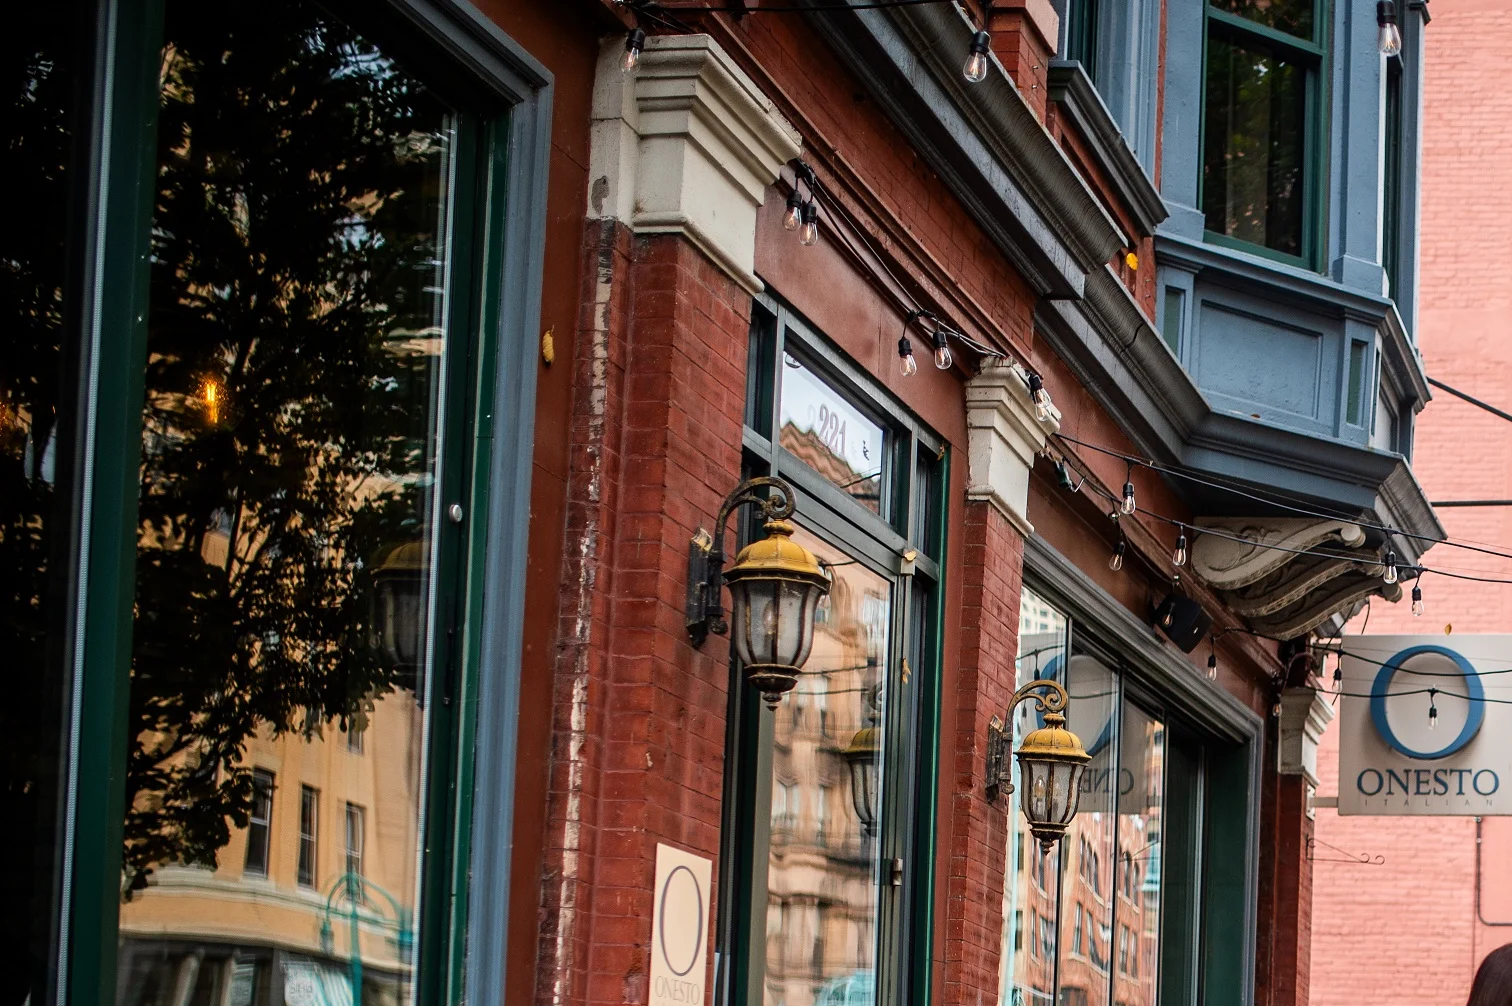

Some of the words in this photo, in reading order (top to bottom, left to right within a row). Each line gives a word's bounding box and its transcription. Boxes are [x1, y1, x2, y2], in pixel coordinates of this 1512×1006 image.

[1356, 768, 1500, 797] ONESTO
[1364, 798, 1493, 808] ITALIAN
[654, 975, 701, 1006] ONESTO
